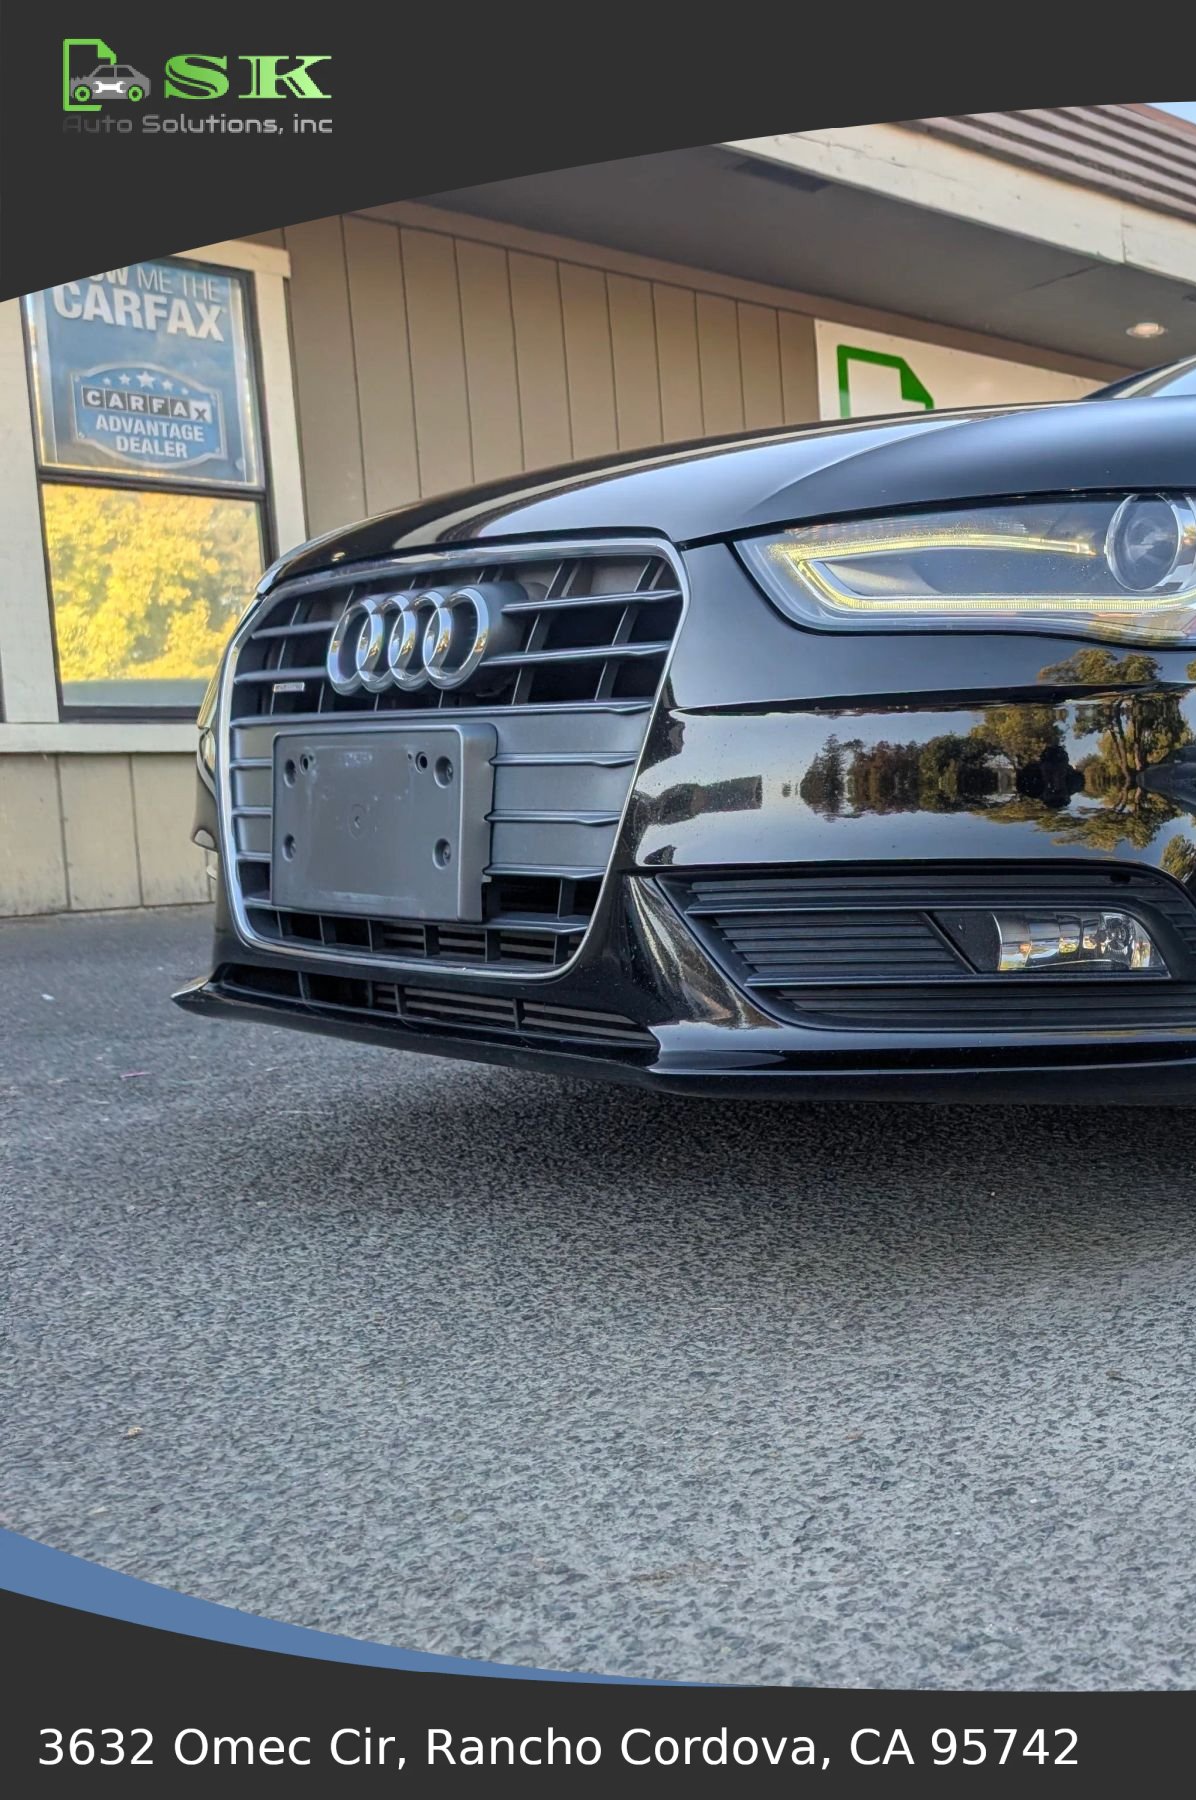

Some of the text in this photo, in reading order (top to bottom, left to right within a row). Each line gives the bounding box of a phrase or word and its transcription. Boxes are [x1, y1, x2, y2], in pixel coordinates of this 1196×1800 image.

[136, 264, 173, 294] ME
[182, 272, 222, 302] THE
[53, 281, 224, 342] CARFAX
[84, 388, 210, 423] CARFAX
[96, 413, 204, 442] ADVANTAGE
[115, 435, 188, 458] DEALER
